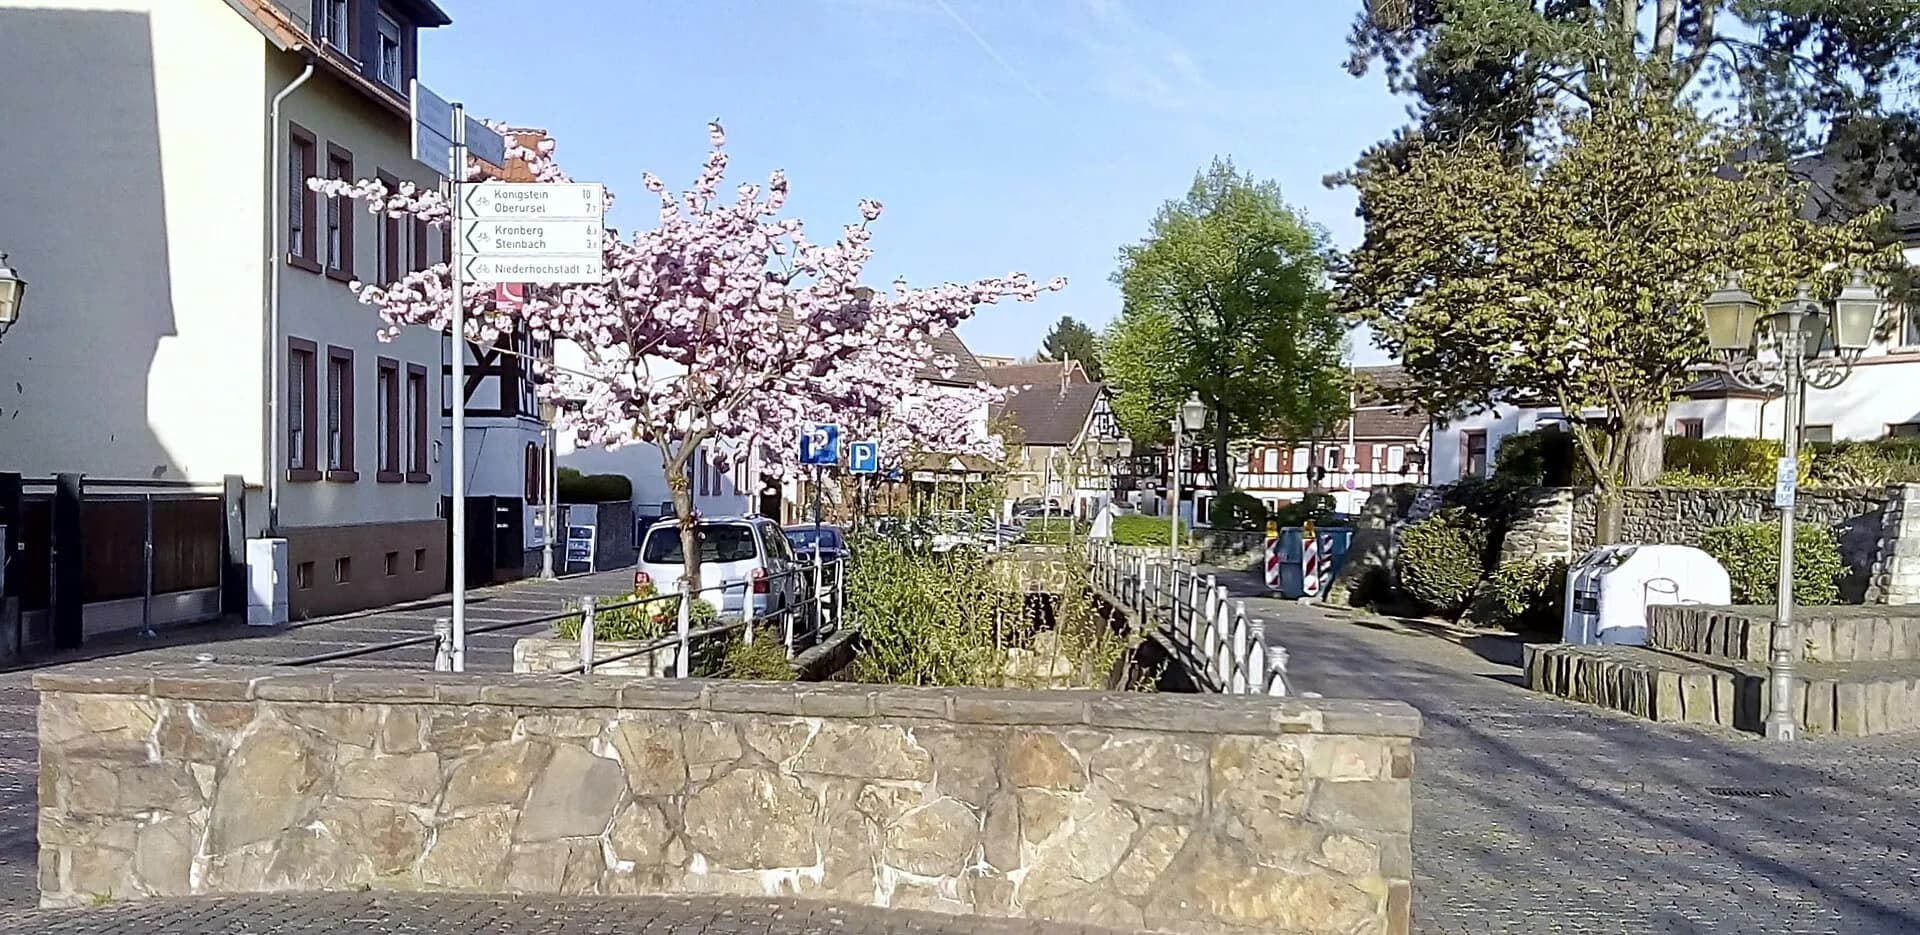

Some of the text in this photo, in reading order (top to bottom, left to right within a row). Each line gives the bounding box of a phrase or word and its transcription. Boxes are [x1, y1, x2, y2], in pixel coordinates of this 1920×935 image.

[582, 189, 591, 199] 10
[494, 203, 546, 213] Oberursel
[495, 225, 543, 237] Kronberg
[495, 239, 546, 249] Steinbach
[495, 264, 580, 274] Niederhochstadt
[808, 429, 829, 459] P
[855, 445, 871, 469] P
